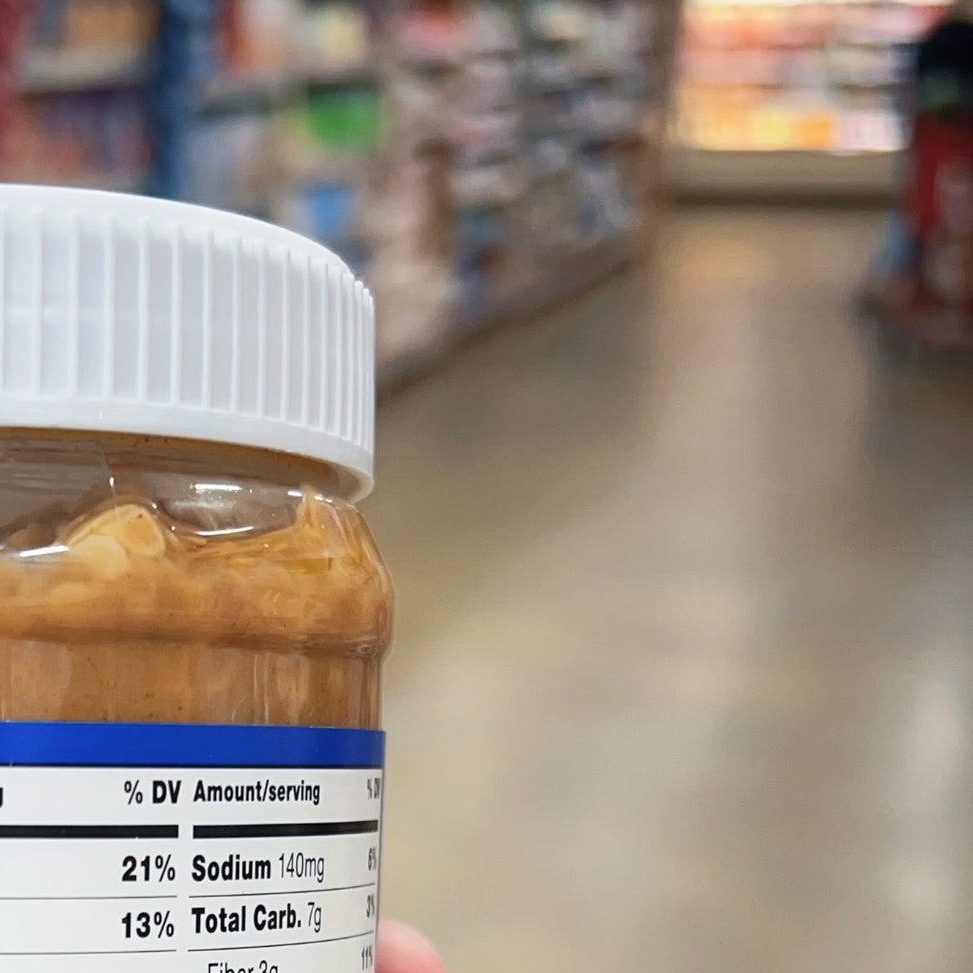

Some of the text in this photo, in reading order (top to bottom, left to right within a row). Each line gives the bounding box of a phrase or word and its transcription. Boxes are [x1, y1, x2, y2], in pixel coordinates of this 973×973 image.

[124, 780, 143, 805] %
[152, 780, 181, 803] DV
[193, 780, 321, 806] Amount/serving
[122, 856, 176, 882] 21%
[192, 854, 271, 882] Sodium
[278, 852, 325, 884] 140mg
[121, 911, 175, 939] 13%
[191, 906, 246, 934] Total
[254, 903, 302, 930] Carb.
[307, 901, 322, 933] 7g
